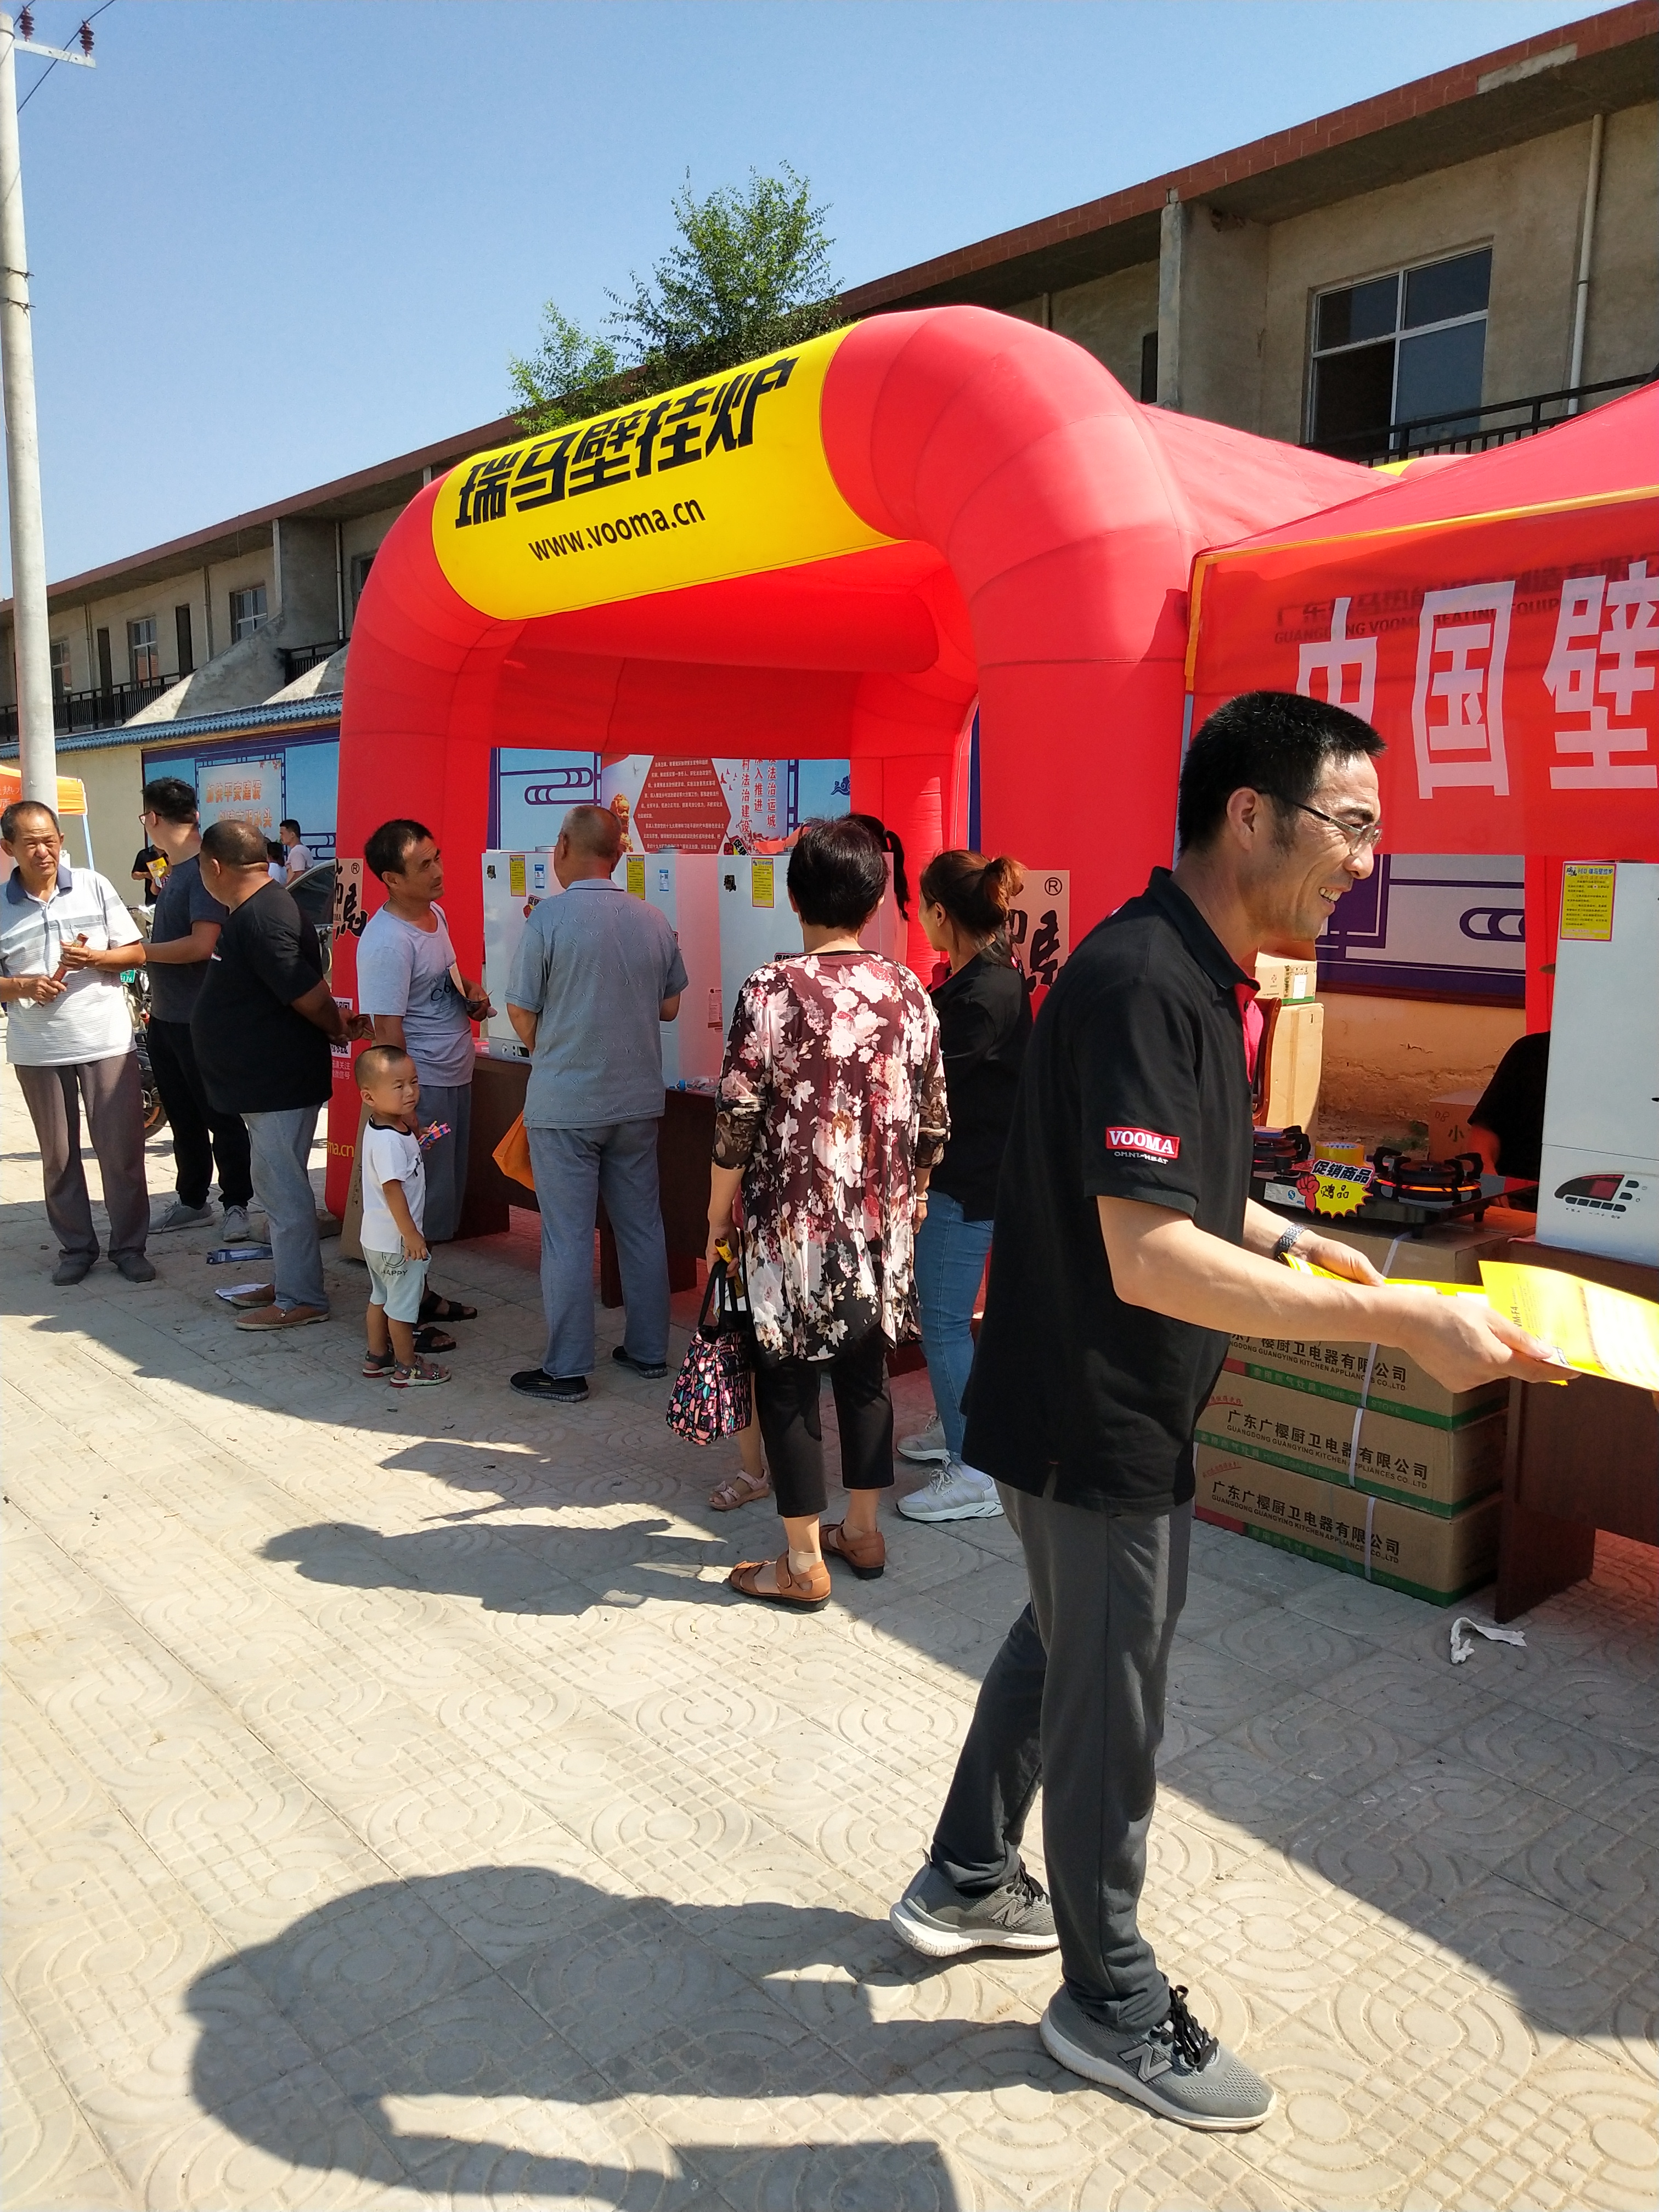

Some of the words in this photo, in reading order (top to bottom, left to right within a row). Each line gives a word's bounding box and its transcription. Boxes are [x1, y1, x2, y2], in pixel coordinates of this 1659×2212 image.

[455, 356, 801, 529] 瑞马壁挂炉
[528, 499, 706, 561] www.vooma.cn
[1109, 1131, 1175, 1154] VOOMA
[1312, 1160, 1372, 1184] 促销商品
[1259, 1347, 1299, 1364] GUANGYING
[1300, 1358, 1329, 1372] KITCHEN
[1330, 1367, 1375, 1384] APPLIANCS
[1227, 1425, 1271, 1443] GUANGDONG
[1272, 1438, 1314, 1455] GUANGYING
[1315, 1451, 1347, 1466] KITCHEN
[1211, 1494, 1253, 1514] GUANGDONG
[1254, 1507, 1294, 1527] GUANGYING
[1294, 1522, 1325, 1538] KITCHEN
[1325, 1533, 1365, 1553] APPLIANCE
